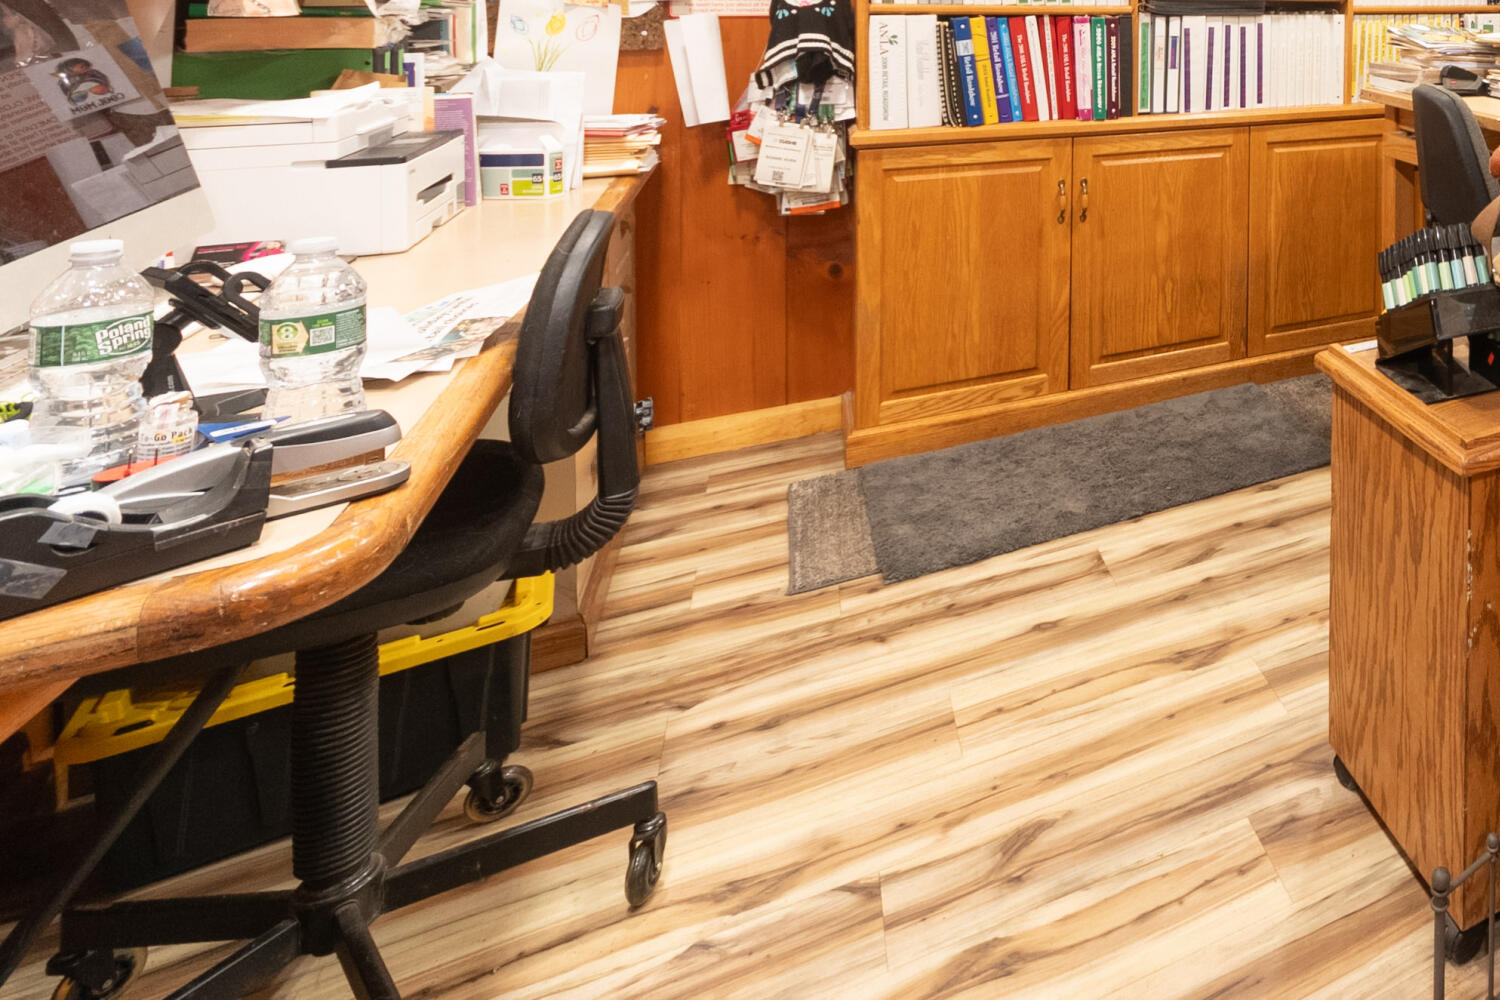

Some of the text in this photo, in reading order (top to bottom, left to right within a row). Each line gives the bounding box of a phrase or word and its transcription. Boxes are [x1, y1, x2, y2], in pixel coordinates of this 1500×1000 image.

[880, 23, 888, 56] ANLA
[992, 44, 1001, 62] Retail
[963, 56, 976, 107] Retail Roadshow
[994, 62, 1004, 93] Roadshow
[95, 315, 150, 343] Poland
[97, 328, 151, 355] Spring
